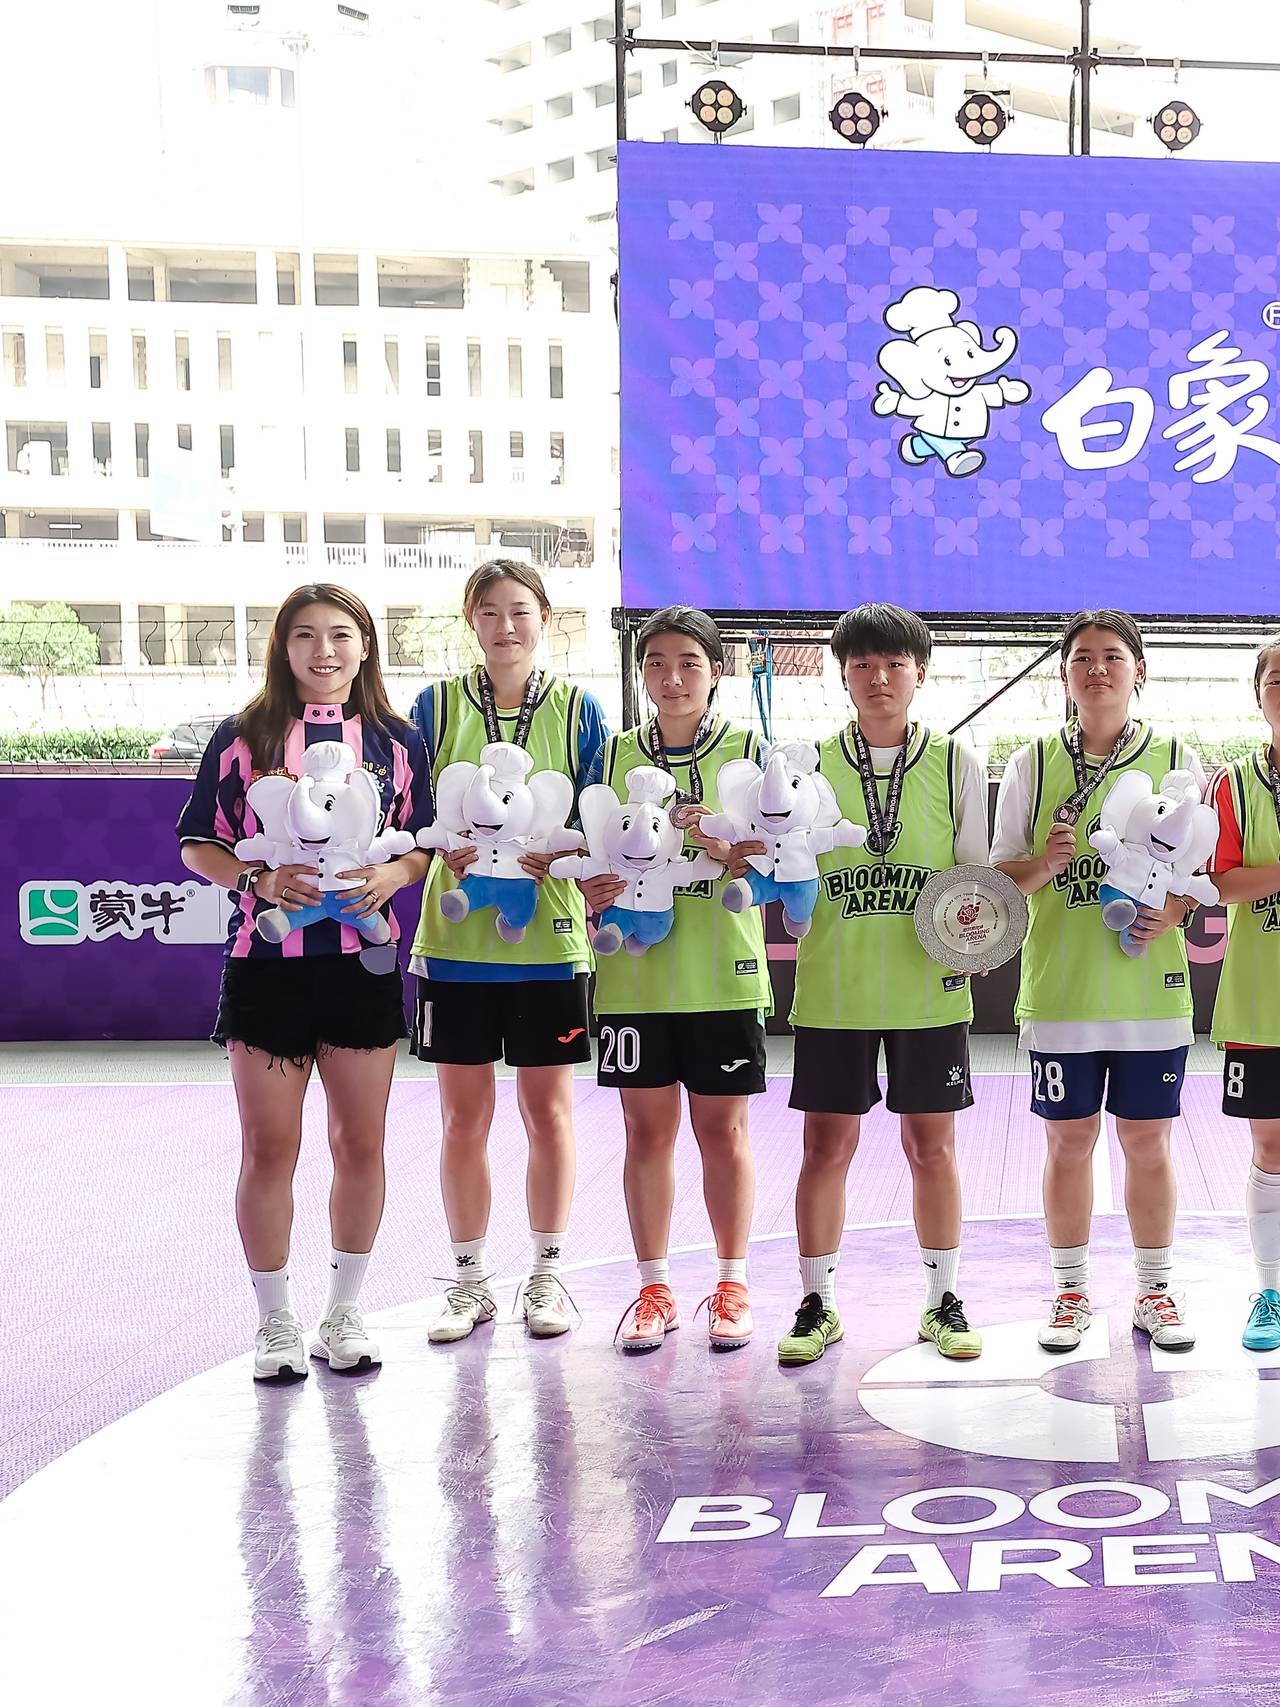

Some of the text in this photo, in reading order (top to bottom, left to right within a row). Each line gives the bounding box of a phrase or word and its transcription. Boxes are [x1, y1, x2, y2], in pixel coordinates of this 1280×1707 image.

[487, 715, 495, 735] WORLD
[891, 767, 901, 789] WORLD
[1082, 779, 1095, 795] YOUR
[866, 792, 877, 814] WORLD
[887, 795, 897, 813] YOUR
[826, 866, 932, 898] BLOOMIN
[90, 889, 186, 935] 蒙牛
[600, 1026, 641, 1073] 20
[1033, 1060, 1065, 1102] 28
[1227, 1061, 1245, 1098] 8
